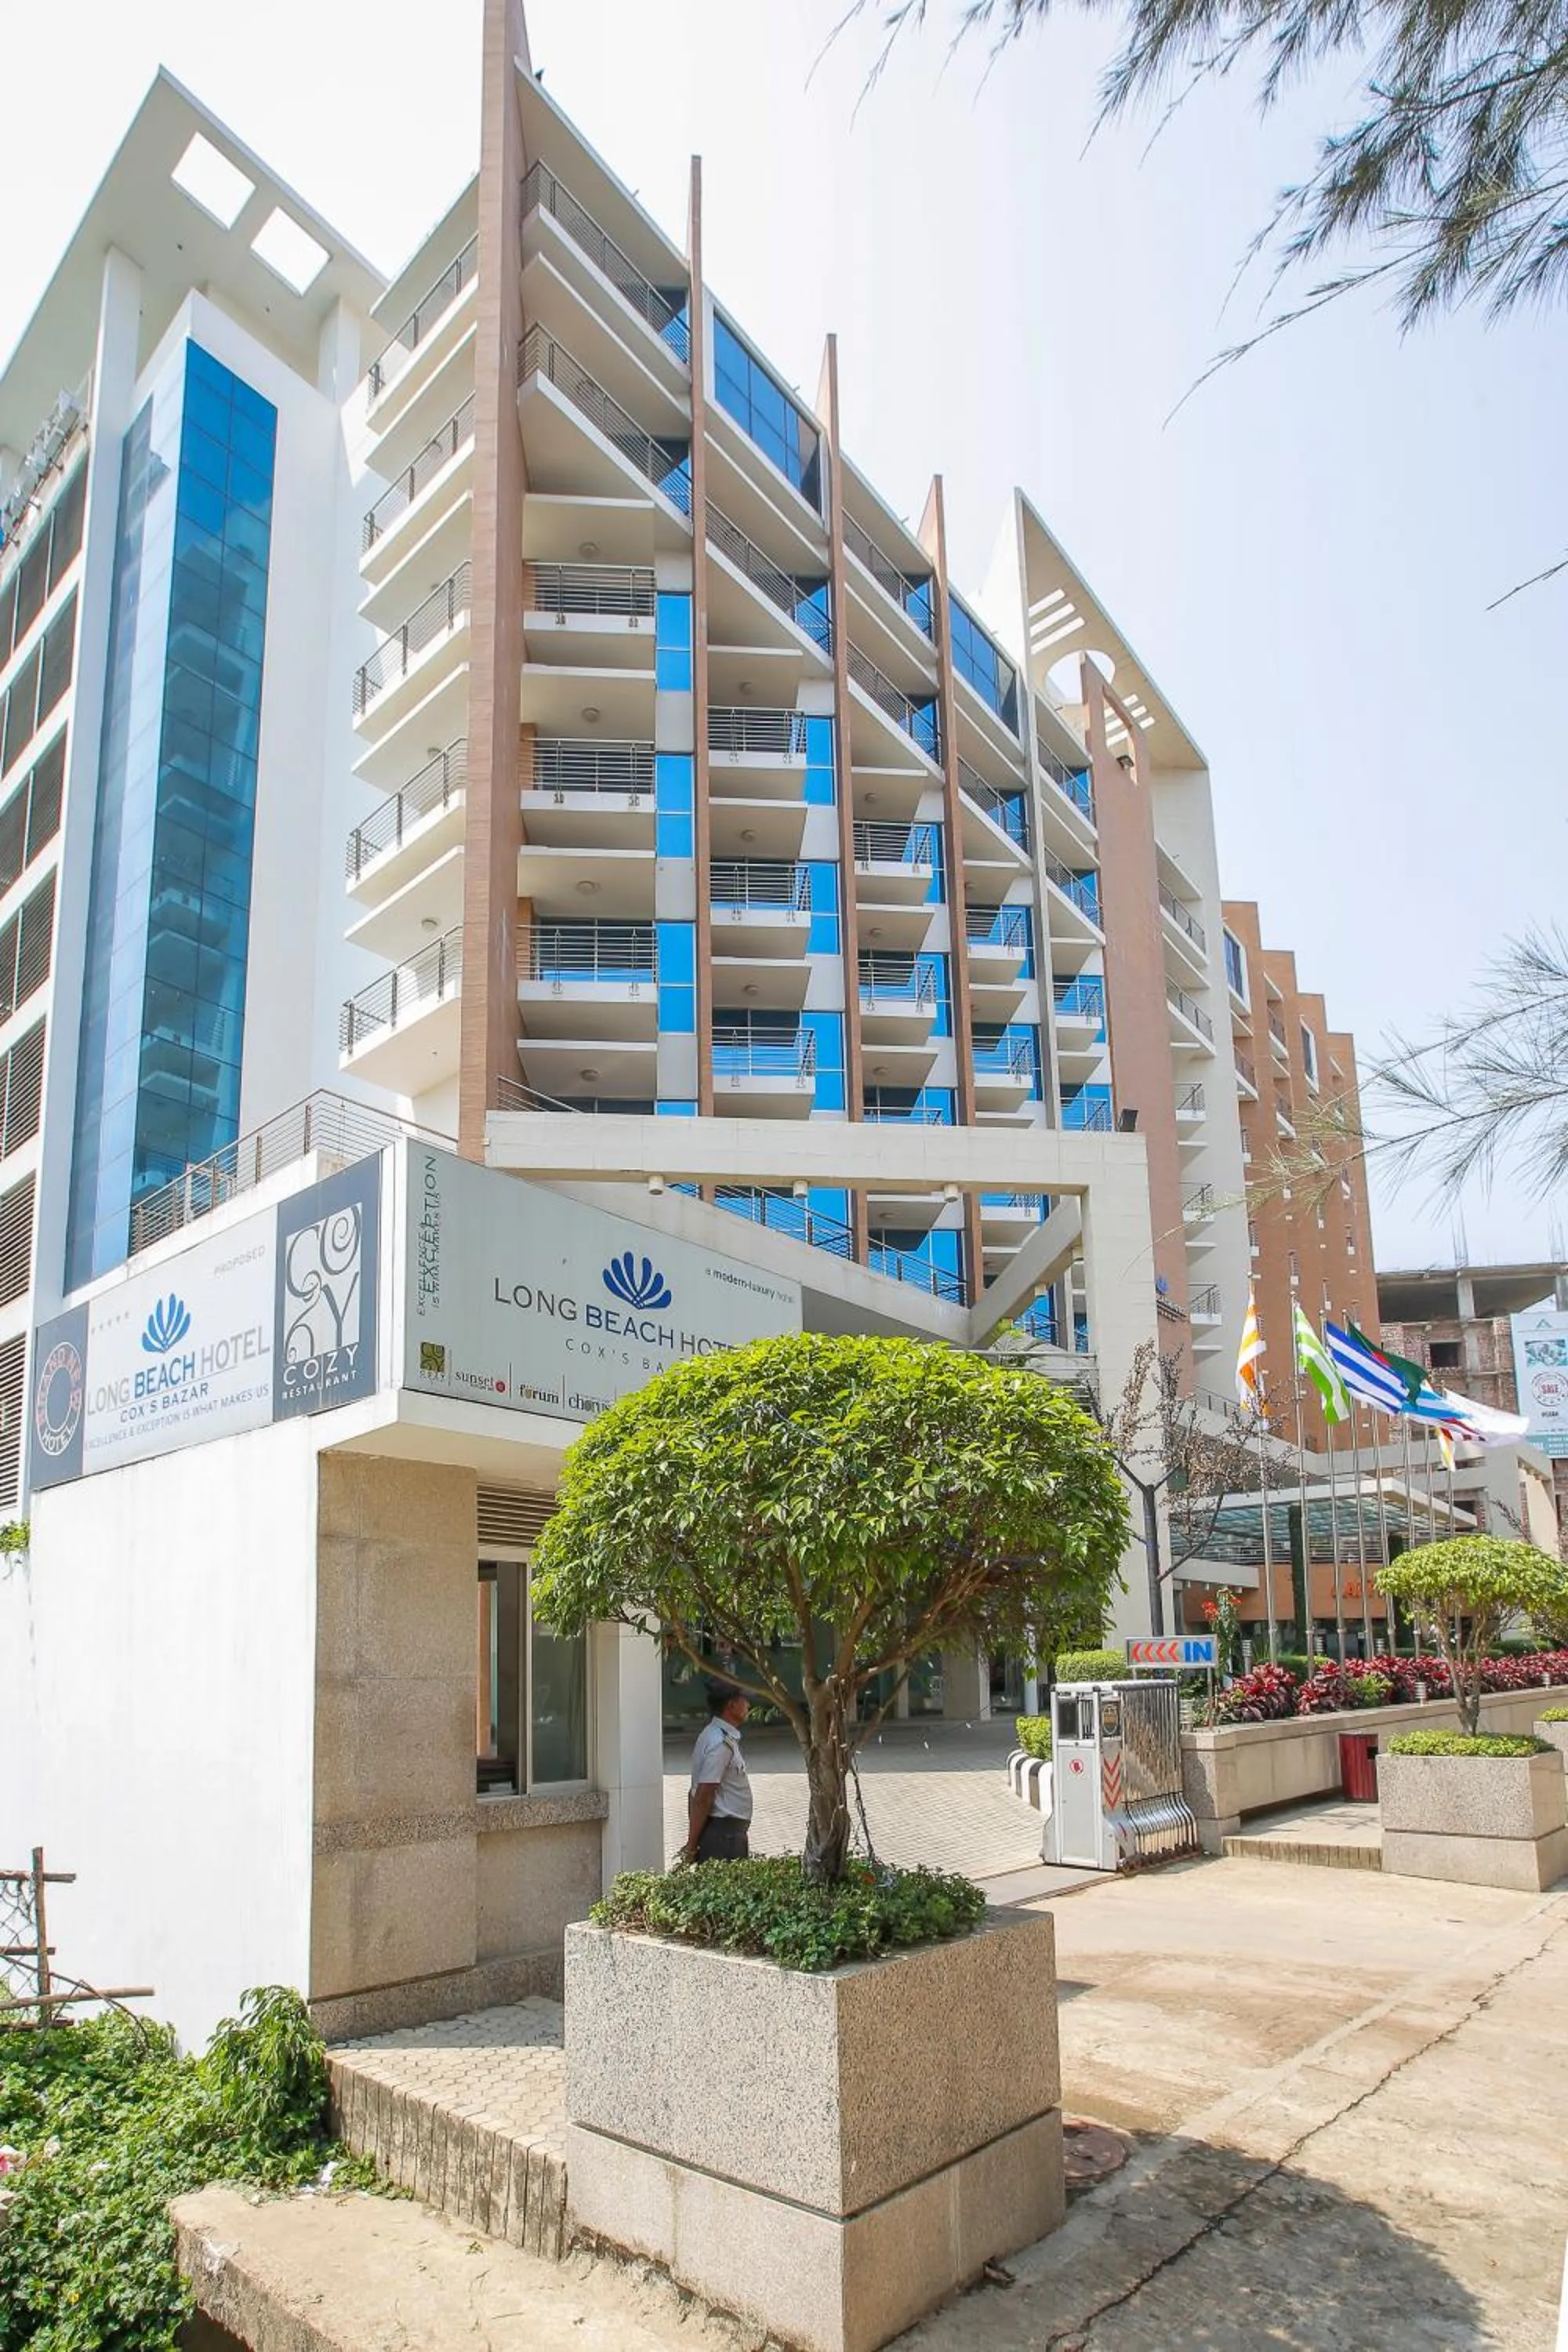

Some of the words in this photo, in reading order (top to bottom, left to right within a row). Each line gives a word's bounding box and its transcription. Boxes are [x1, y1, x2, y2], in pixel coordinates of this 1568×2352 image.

[422, 1155, 437, 1294] EXCEPTION
[713, 1269, 775, 1299] modern-luxury
[495, 1277, 577, 1321] LONG
[586, 1304, 673, 1348] BEACH
[87, 1377, 129, 1416] LONG
[133, 1351, 195, 1399] BEACH
[201, 1326, 270, 1375] HOTEL
[283, 1344, 359, 1386] COZY
[565, 1338, 630, 1365] COX'S
[455, 1370, 494, 1387] sunset
[120, 1400, 157, 1423] COX'S
[162, 1382, 209, 1409] BAZAR
[136, 1410, 180, 1436] EXCEPTION
[183, 1410, 190, 1421] IS
[194, 1400, 218, 1417] WHAT
[220, 1389, 252, 1408] MAKES
[256, 1383, 269, 1399] US
[42, 1425, 75, 1452] HOTEL
[1185, 1642, 1212, 1663] IN
